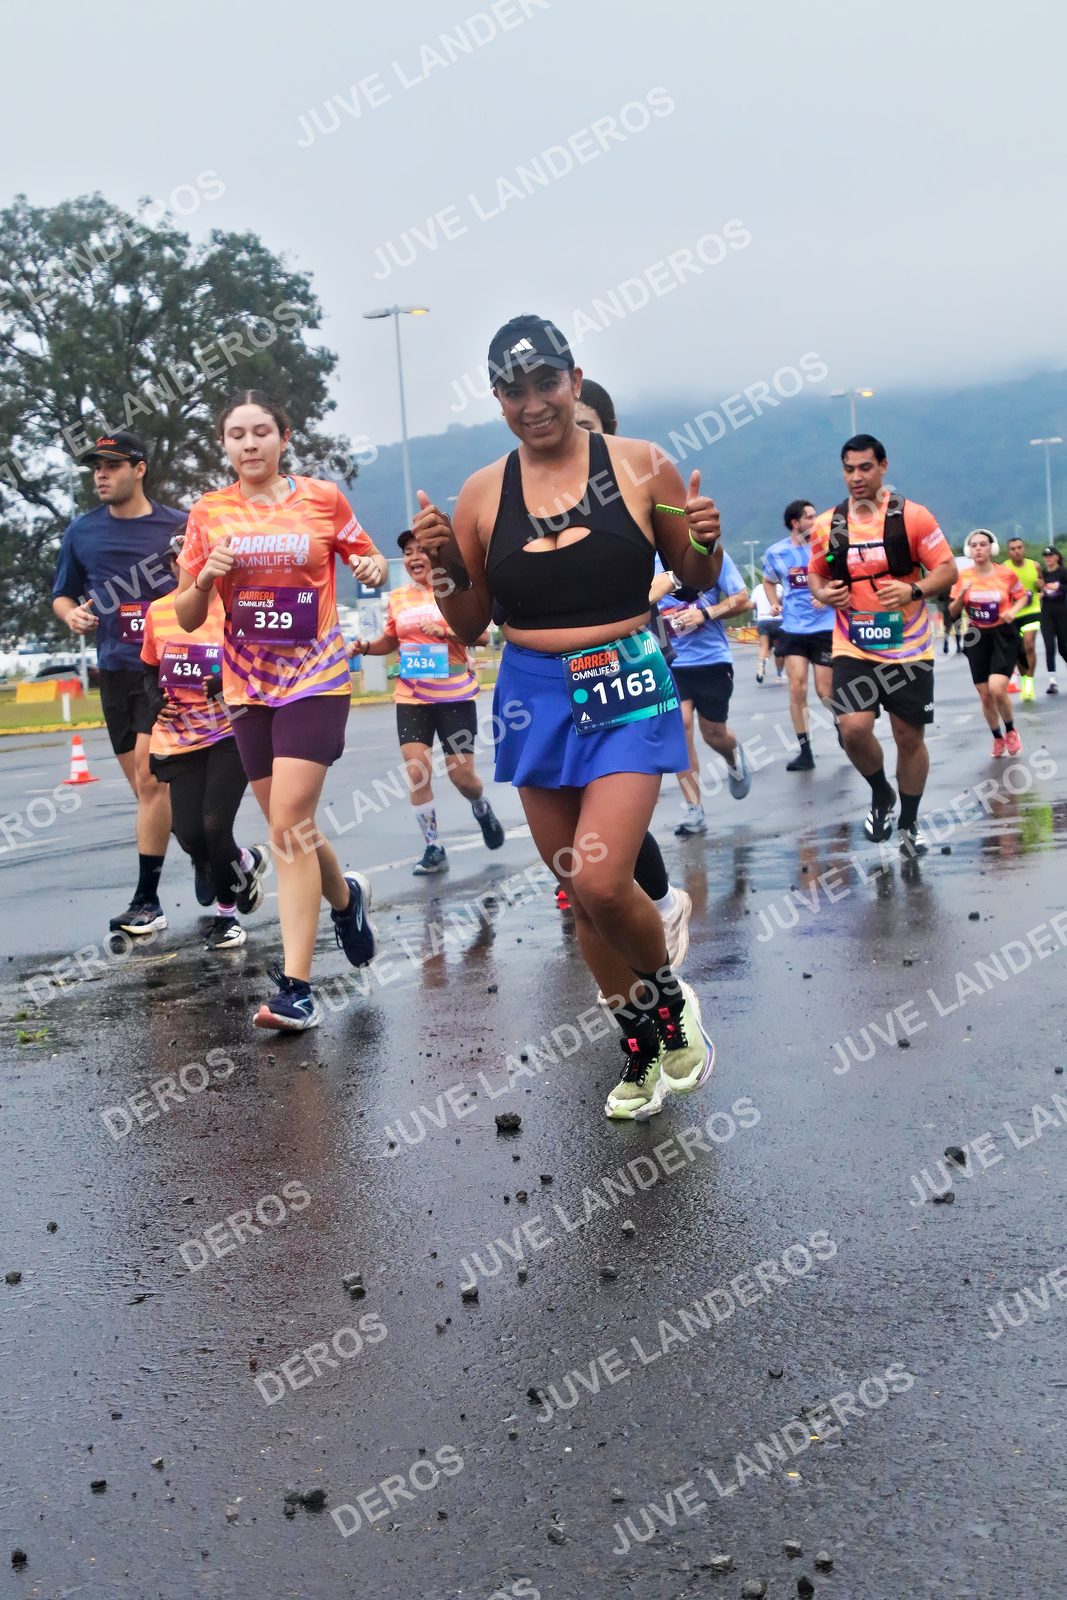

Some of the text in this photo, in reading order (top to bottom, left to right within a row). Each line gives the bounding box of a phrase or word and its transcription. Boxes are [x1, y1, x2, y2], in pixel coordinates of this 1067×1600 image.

[229, 534, 310, 554] CARRERA
[239, 591, 313, 604] CARRERA 15K
[130, 618, 146, 631] 67
[254, 611, 292, 629] 329
[858, 628, 891, 638] 1008
[406, 658, 436, 668] 2434
[570, 649, 620, 672] CARRERA
[172, 662, 202, 676] 434
[592, 669, 656, 704] 1163
